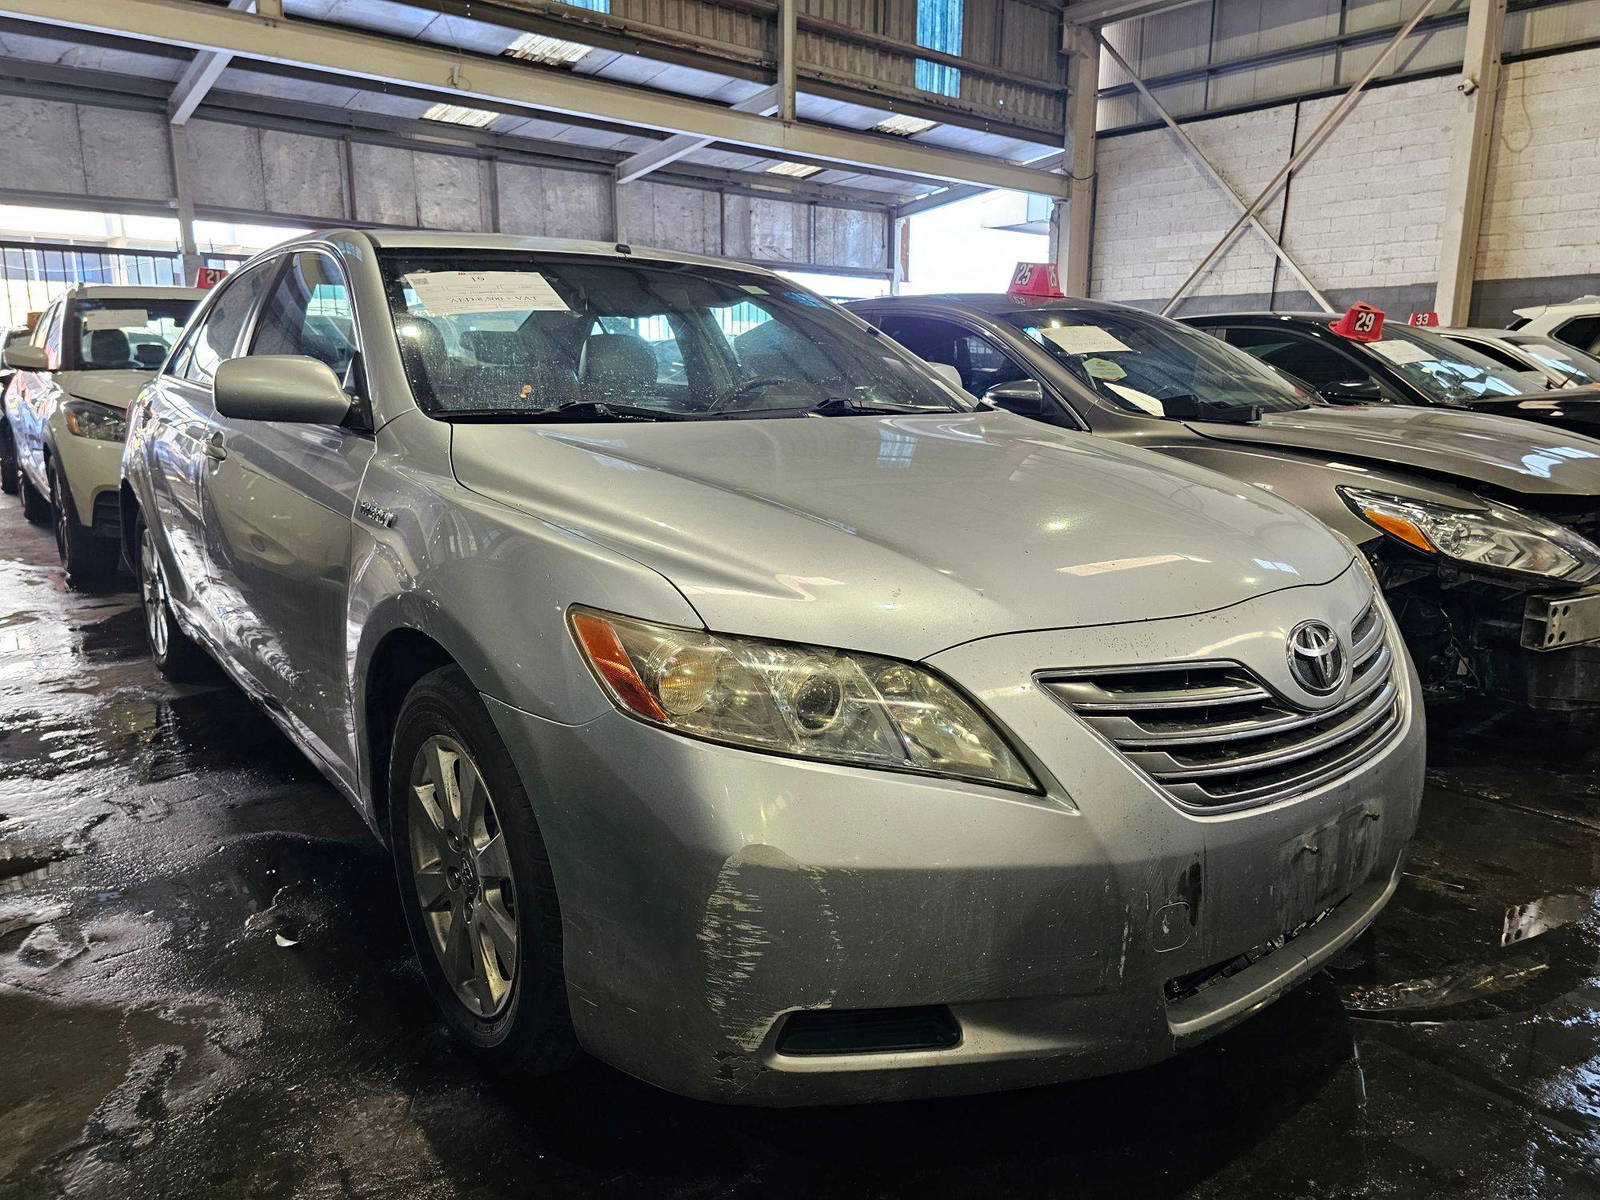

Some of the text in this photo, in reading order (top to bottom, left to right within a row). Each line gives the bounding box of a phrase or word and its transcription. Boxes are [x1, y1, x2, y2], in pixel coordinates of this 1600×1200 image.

[206, 270, 220, 284] 21
[1015, 263, 1033, 285] 25
[1355, 312, 1375, 332] 29
[1416, 314, 1429, 325] 33
